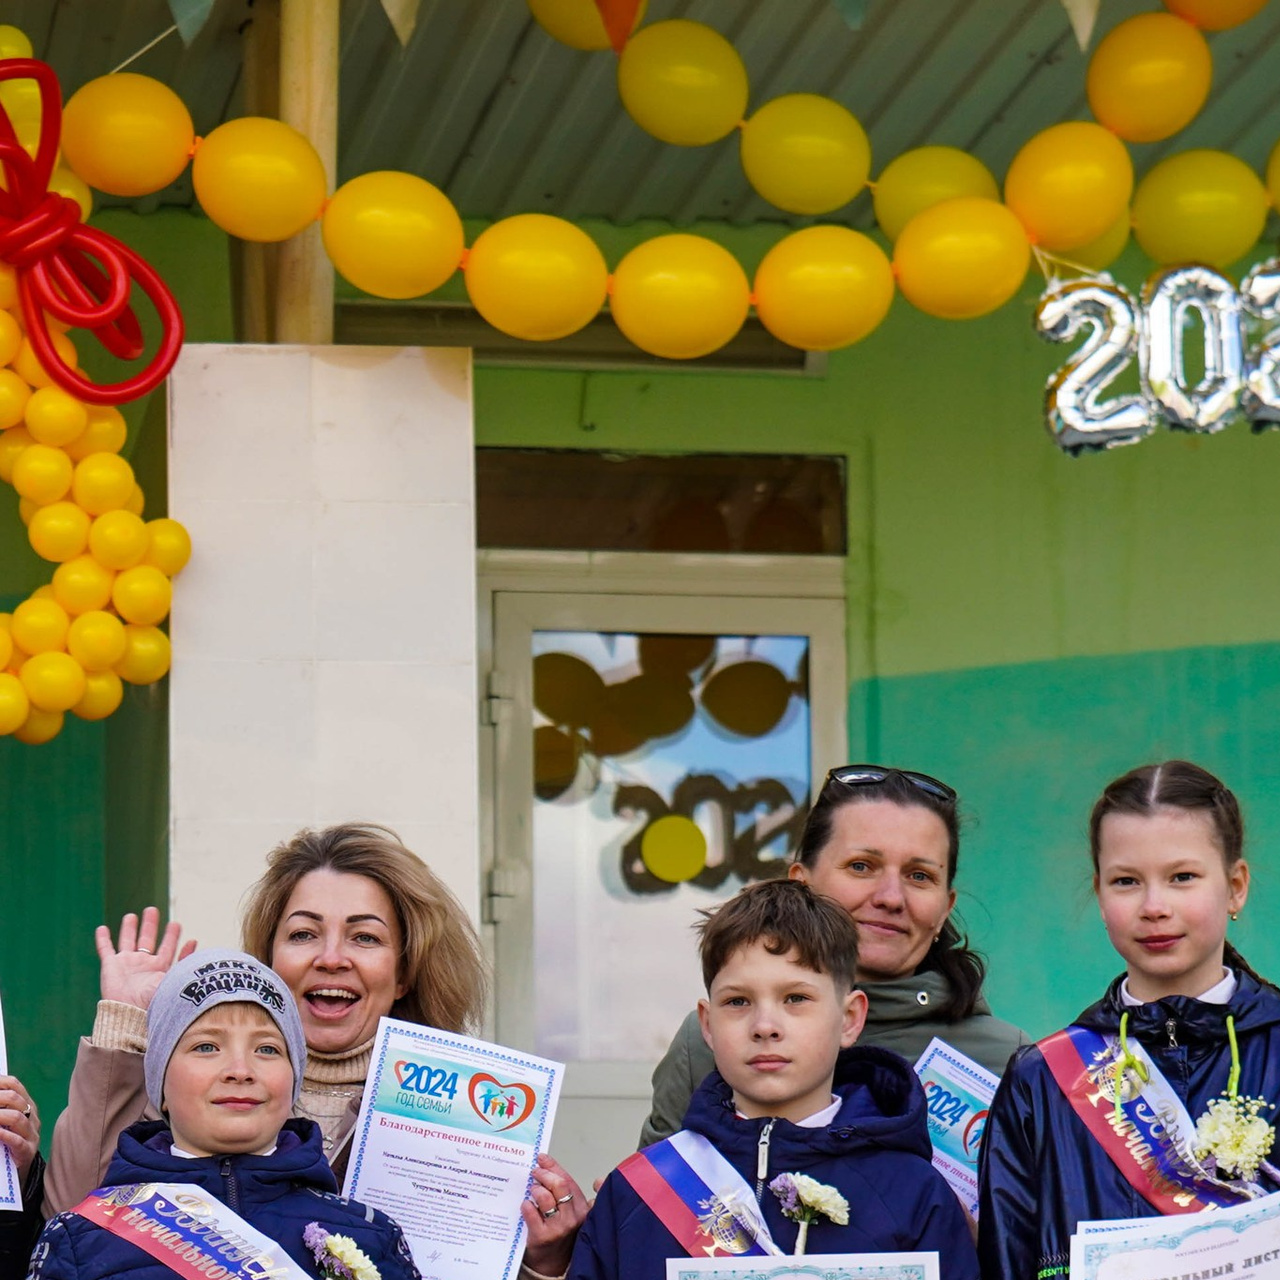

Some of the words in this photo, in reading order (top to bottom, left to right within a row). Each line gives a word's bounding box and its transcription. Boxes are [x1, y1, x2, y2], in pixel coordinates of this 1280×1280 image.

[396, 1092, 415, 1107] ГОД
[400, 1062, 458, 1100] 2024
[928, 1084, 970, 1127] 2024
[379, 1117, 481, 1148] Благодарственное
[483, 1142, 526, 1156] письмо
[1242, 1250, 1280, 1268] ЛИСТ
